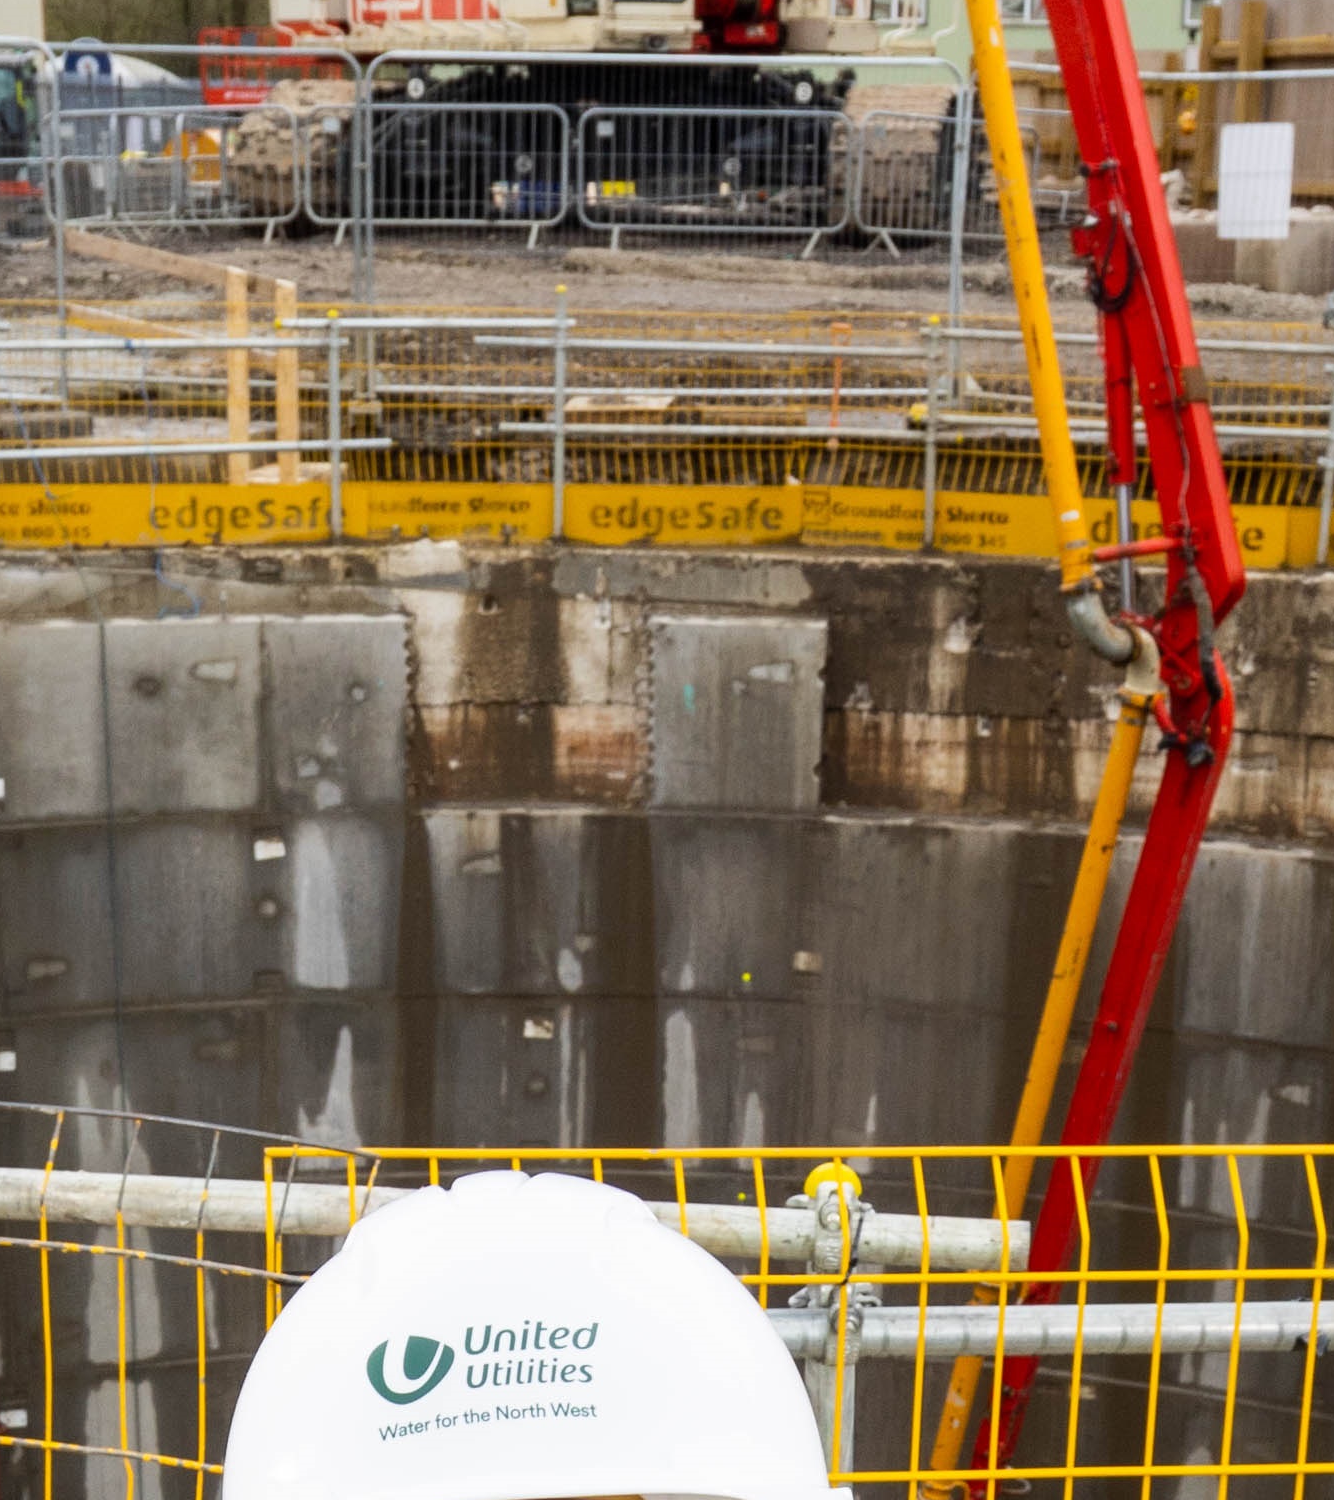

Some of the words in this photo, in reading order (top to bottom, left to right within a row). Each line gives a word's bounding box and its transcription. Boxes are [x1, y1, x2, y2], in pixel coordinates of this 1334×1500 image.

[589, 498, 785, 537] edgeSafe
[464, 1320, 599, 1355] United
[466, 1358, 593, 1388] Utilities
[379, 1419, 431, 1441] Water
[435, 1413, 458, 1429] for
[463, 1409, 490, 1424] the
[496, 1403, 546, 1421] North
[550, 1403, 597, 1417] West
